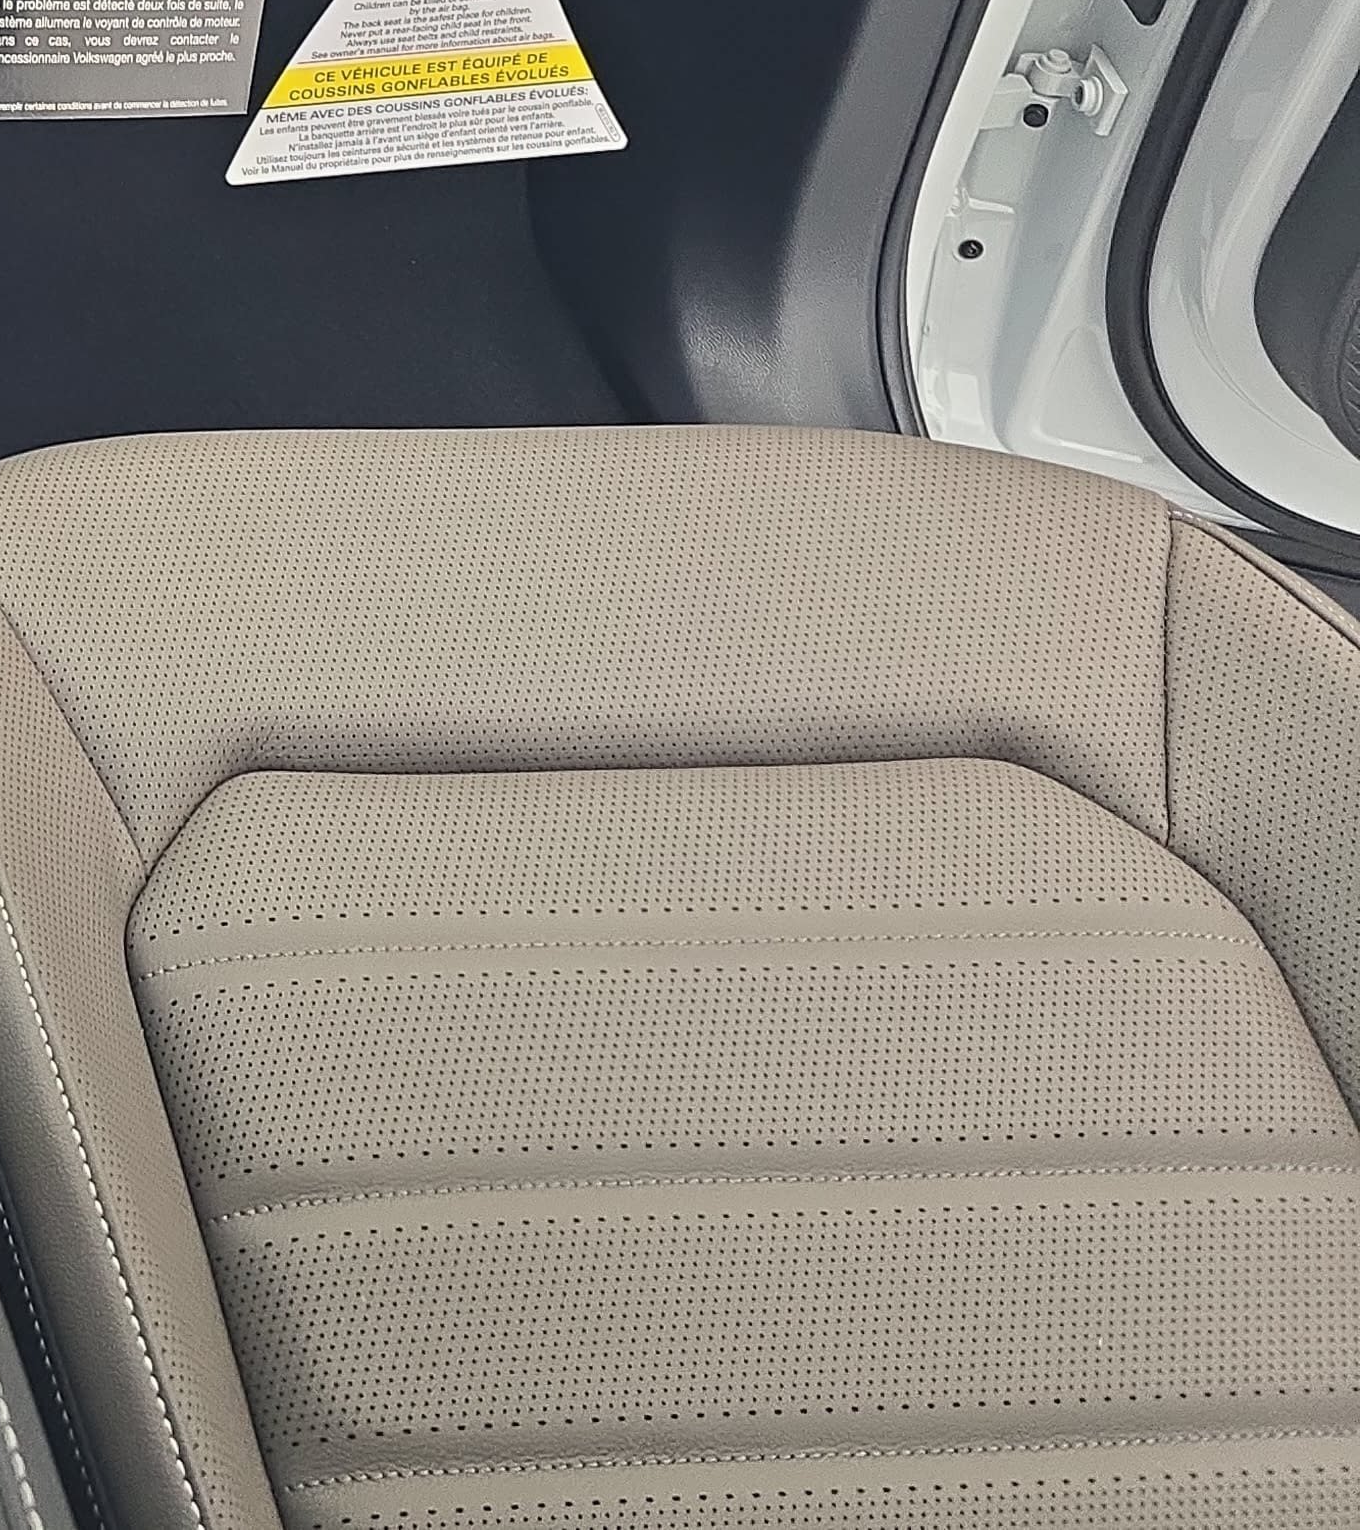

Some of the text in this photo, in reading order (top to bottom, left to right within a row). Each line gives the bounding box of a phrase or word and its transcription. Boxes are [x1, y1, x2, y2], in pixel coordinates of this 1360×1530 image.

[72, 0, 91, 11] est
[137, 0, 164, 10] deux
[353, 1, 391, 11] Children
[34, 16, 80, 28] allumera
[82, 16, 92, 28] le
[94, 17, 129, 30] voyant
[131, 16, 145, 28] de
[189, 15, 203, 28] de
[204, 16, 240, 27] moteur.
[24, 36, 39, 46] ce
[48, 36, 71, 47] cas,
[84, 36, 111, 46] vous
[123, 34, 159, 46] devrez
[170, 33, 220, 45] contacter
[229, 32, 239, 44] le
[72, 51, 133, 65] Volkswagen
[165, 50, 175, 63] le
[176, 50, 198, 65] plus
[199, 50, 236, 63] proche.
[314, 52, 548, 83] CE VÉHICULE EST ÉQUIPÉ DE
[289, 65, 569, 101] COUSSINS GONFLABLES ÉVOLUÉS
[266, 86, 589, 123] MÊME AVEC DES COUSSINS GONFLABLES ÉVOLUÉS:
